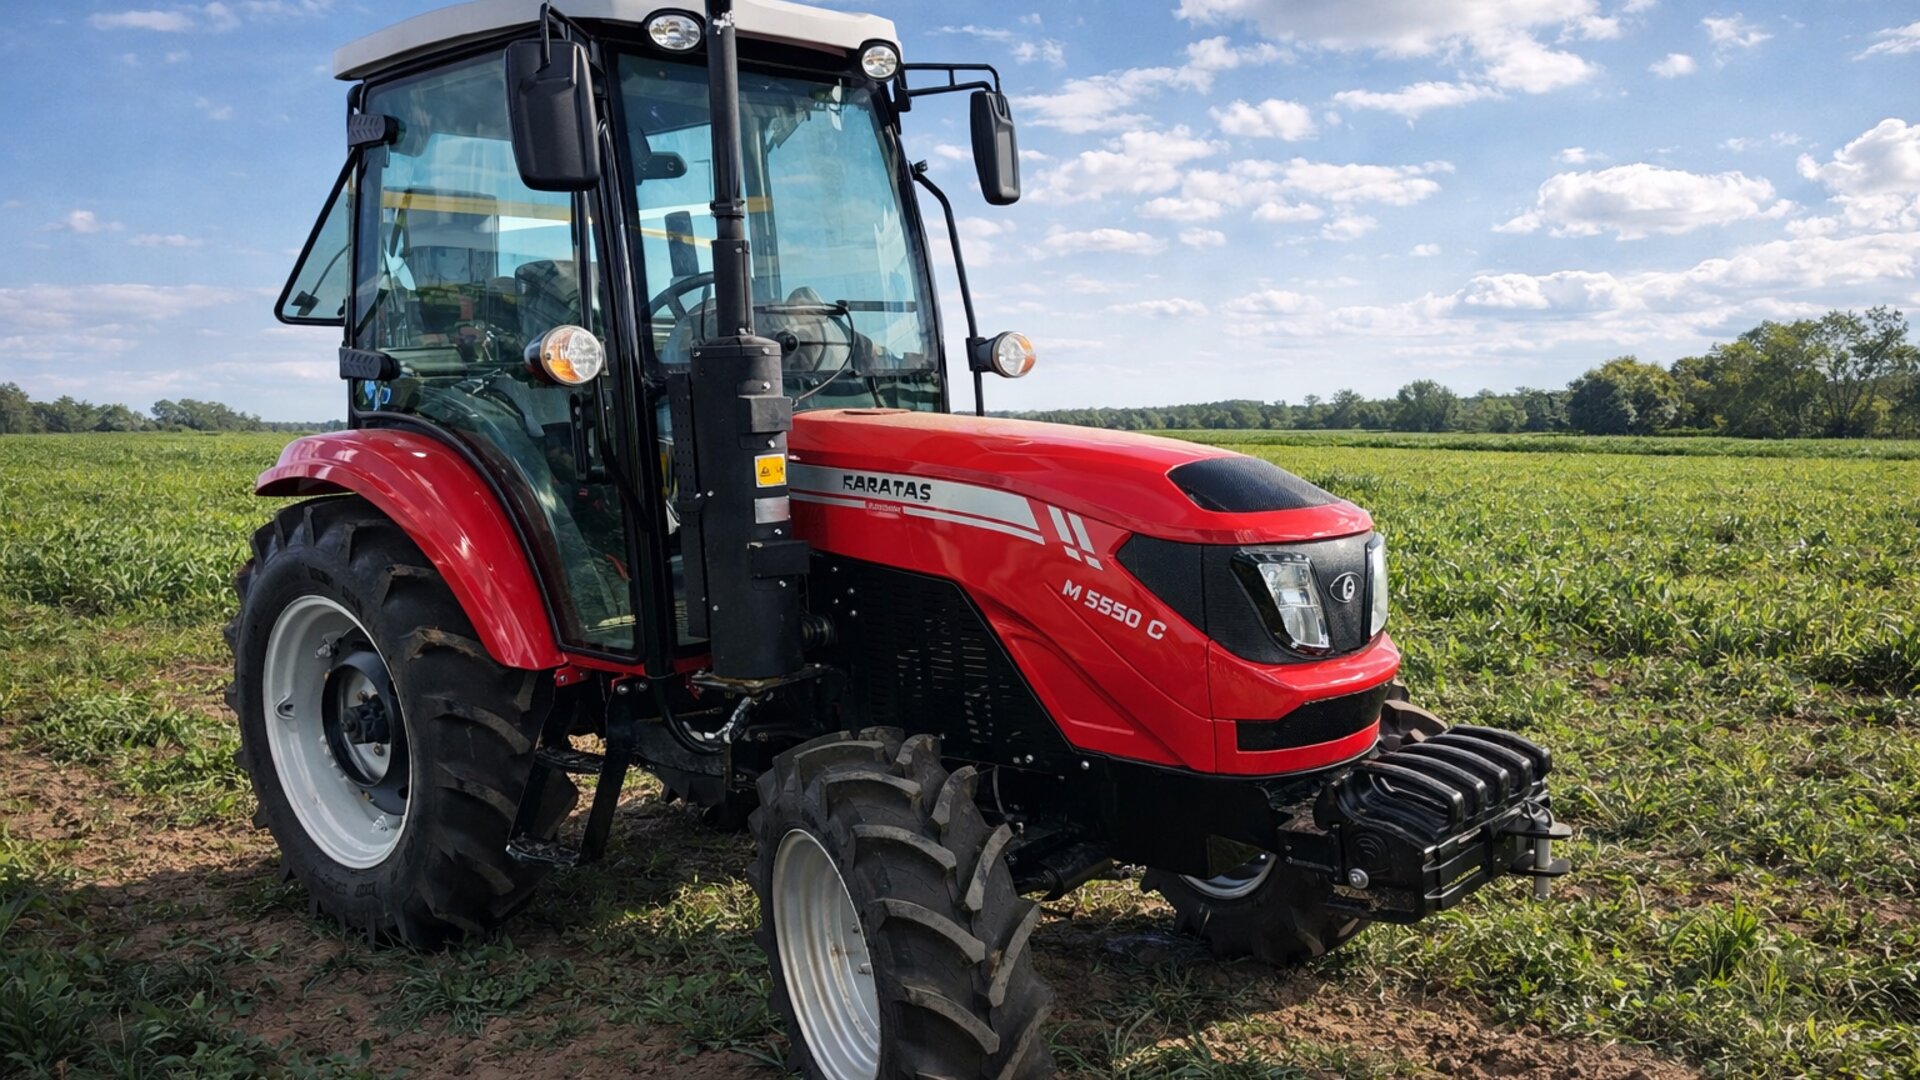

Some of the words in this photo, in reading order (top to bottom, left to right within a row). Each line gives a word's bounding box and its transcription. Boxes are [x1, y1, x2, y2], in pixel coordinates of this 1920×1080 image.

[1061, 578, 1083, 601] M
[1084, 589, 1142, 629] 5550
[1146, 619, 1167, 640] C
